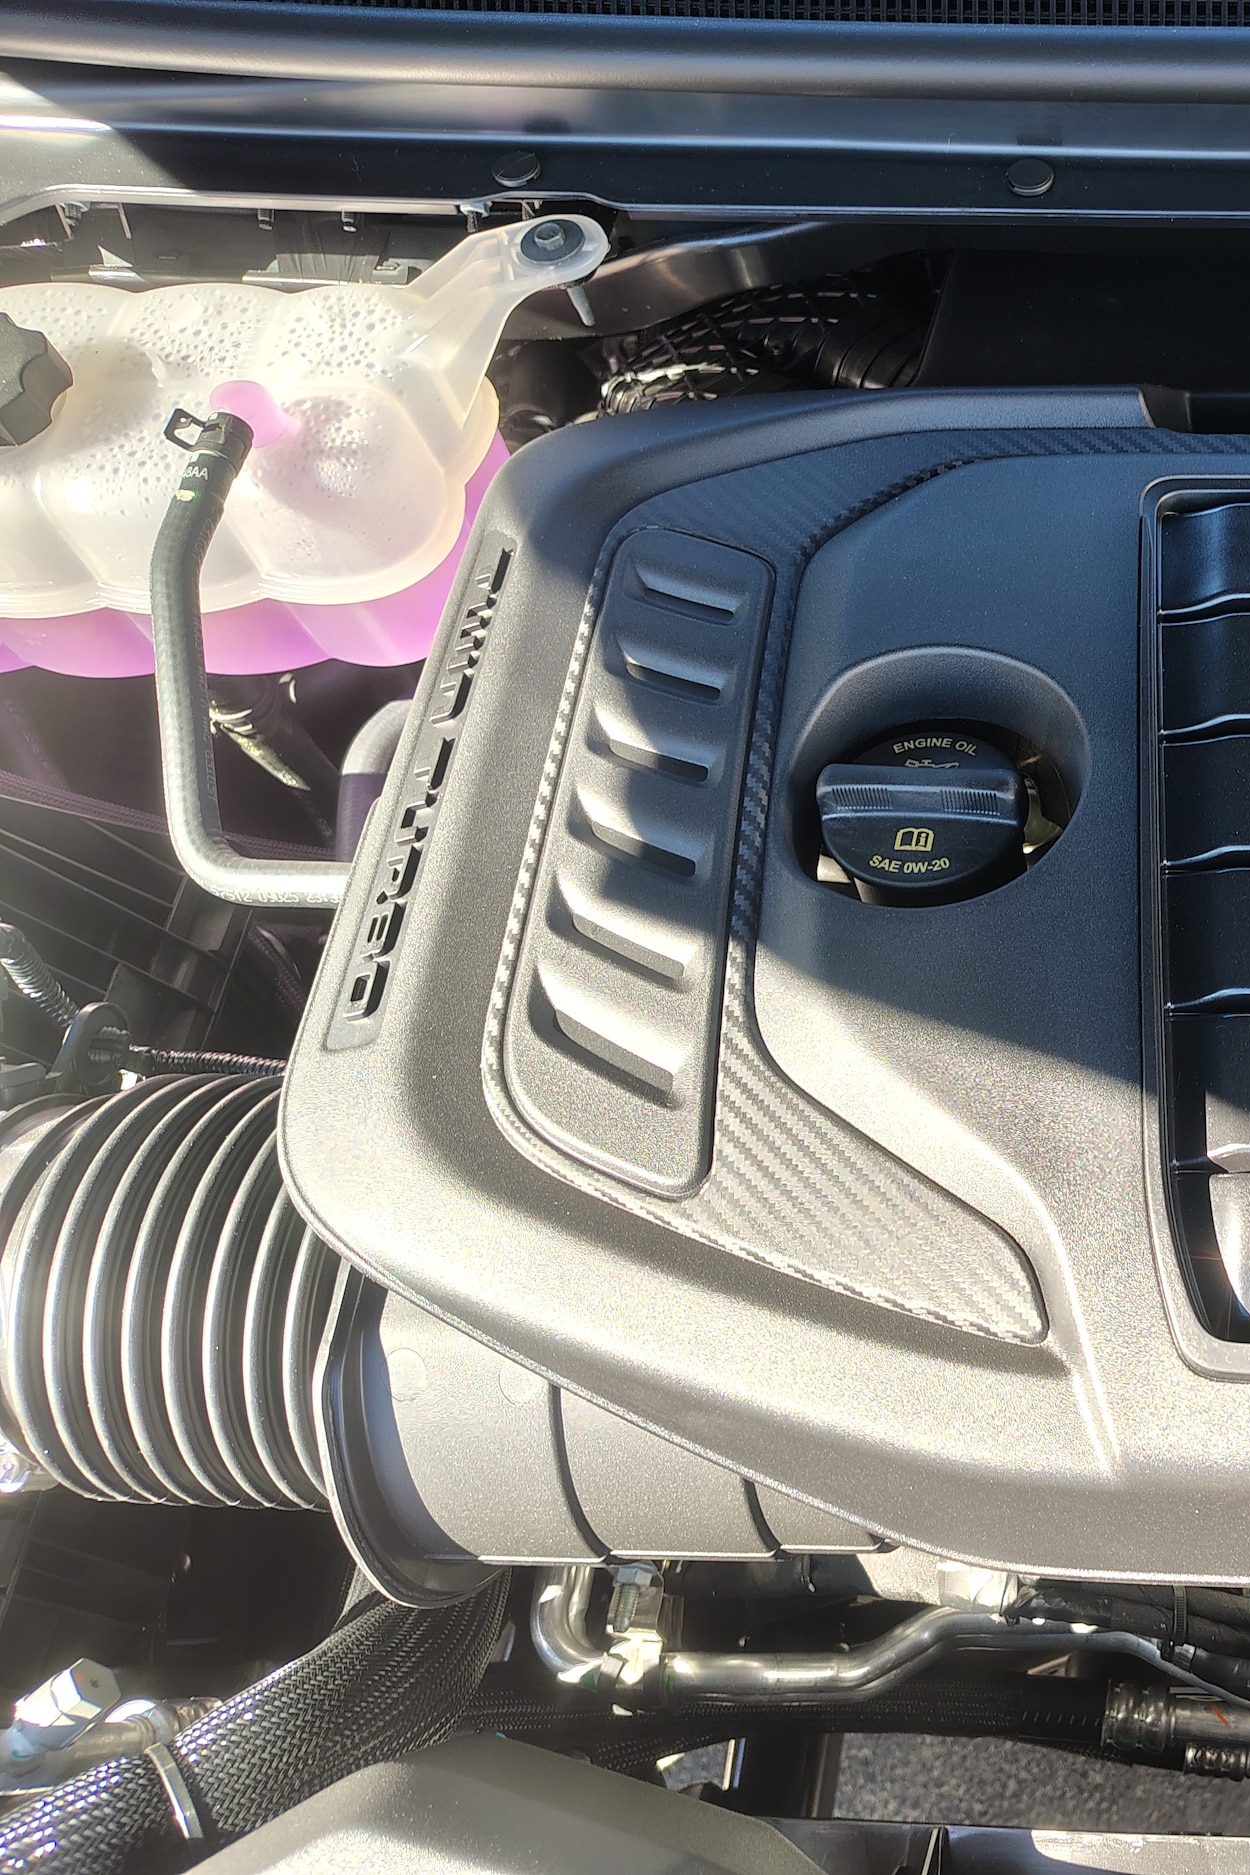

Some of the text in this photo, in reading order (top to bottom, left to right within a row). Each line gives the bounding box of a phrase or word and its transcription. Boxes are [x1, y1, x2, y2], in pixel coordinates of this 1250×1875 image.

[892, 737, 979, 757] ENGINE OIL
[343, 547, 515, 1021] TWIN TURBO
[869, 855, 951, 874] SAE 0W-20
